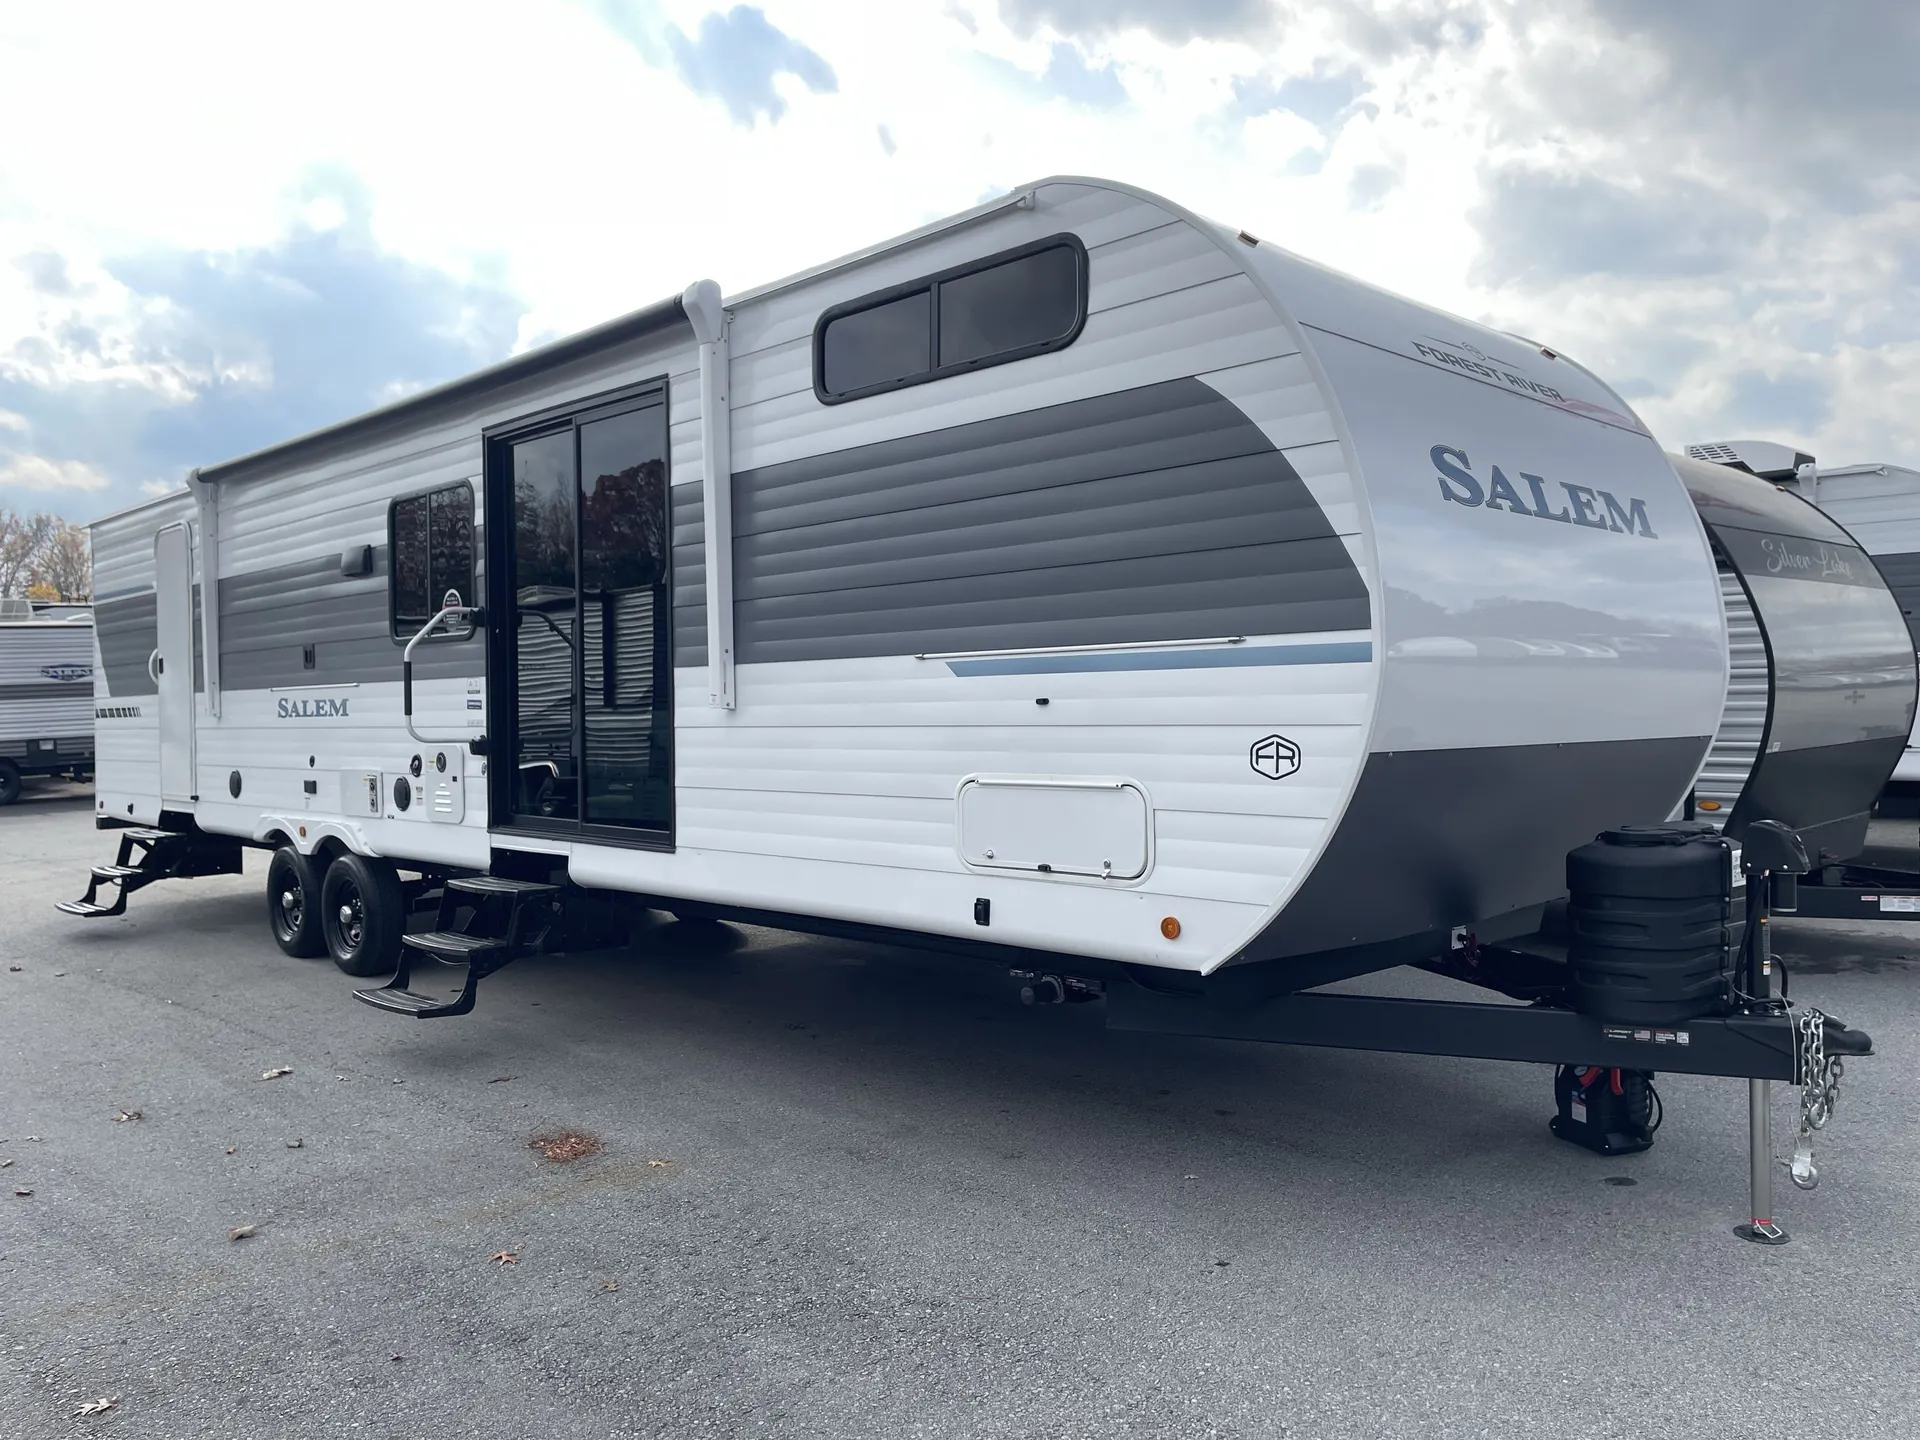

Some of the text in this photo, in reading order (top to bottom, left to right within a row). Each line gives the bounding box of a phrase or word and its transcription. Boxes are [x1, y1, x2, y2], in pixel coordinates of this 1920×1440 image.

[1411, 341, 1566, 403] FOREST RIVER
[1429, 444, 1658, 539] SALEM
[1761, 539, 1854, 580] Silver Lake
[277, 698, 349, 718] SALEM
